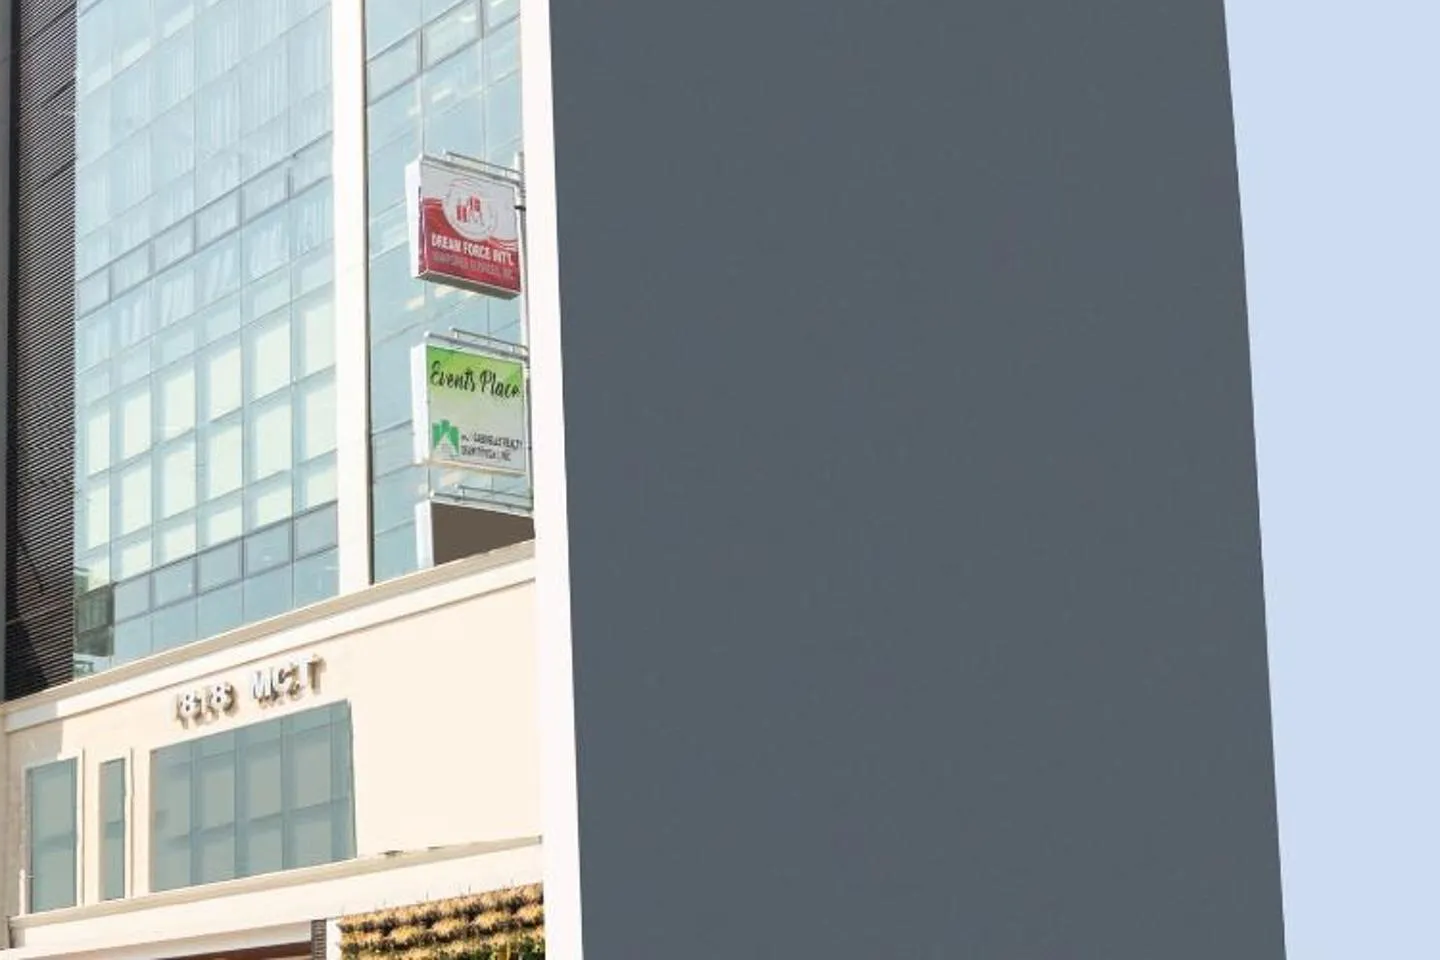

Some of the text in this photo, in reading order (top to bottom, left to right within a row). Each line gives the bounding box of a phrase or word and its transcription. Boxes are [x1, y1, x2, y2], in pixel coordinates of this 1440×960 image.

[431, 233, 461, 253] DREAM
[463, 241, 491, 260] FORCE
[430, 360, 521, 399] Events Place
